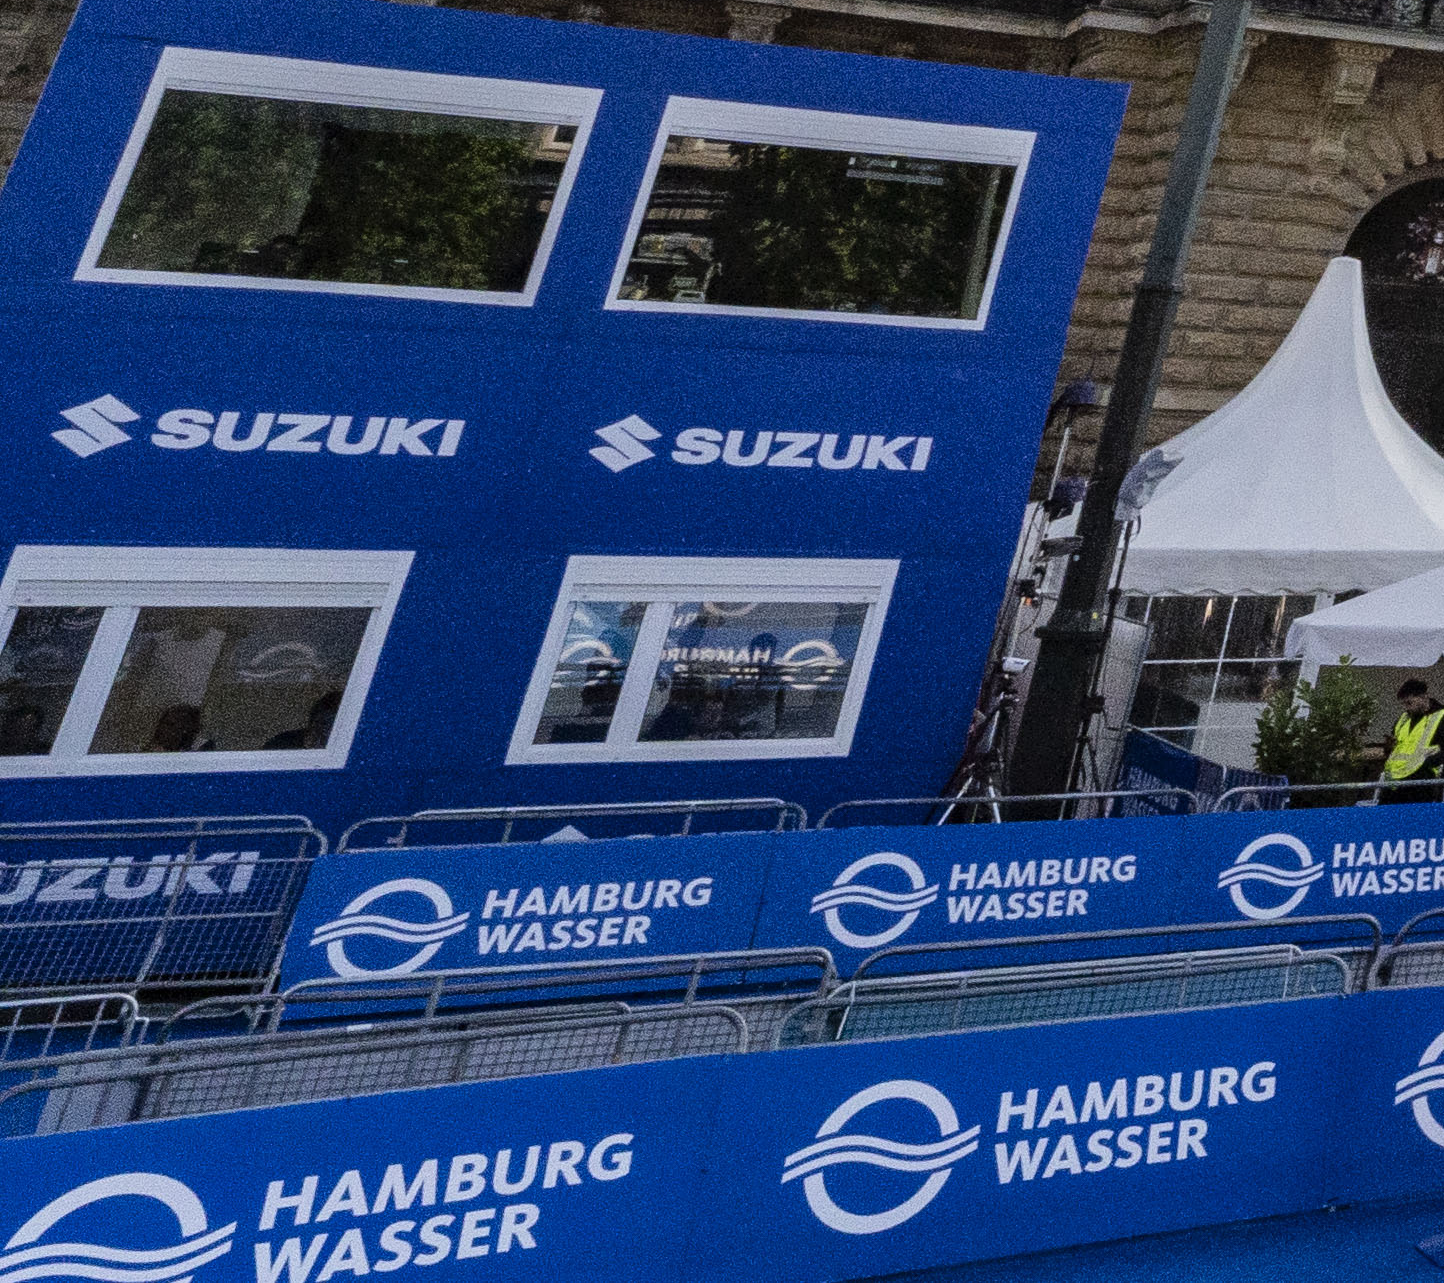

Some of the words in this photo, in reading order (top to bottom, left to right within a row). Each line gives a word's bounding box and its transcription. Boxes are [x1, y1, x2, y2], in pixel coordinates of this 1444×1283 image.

[152, 408, 466, 458] SUZUKI
[672, 427, 933, 471] SUZUKI
[0, 851, 260, 906] UZUKI
[483, 878, 714, 918] HAMBURG
[948, 855, 1138, 892] HAMBURG
[946, 888, 1090, 924] WASSER
[477, 915, 651, 955] WASSER
[997, 1061, 1278, 1133] HAMBURG
[995, 1117, 1209, 1184] WASSER
[258, 1133, 635, 1231] HAMBURG
[253, 1202, 542, 1283] WASSER
